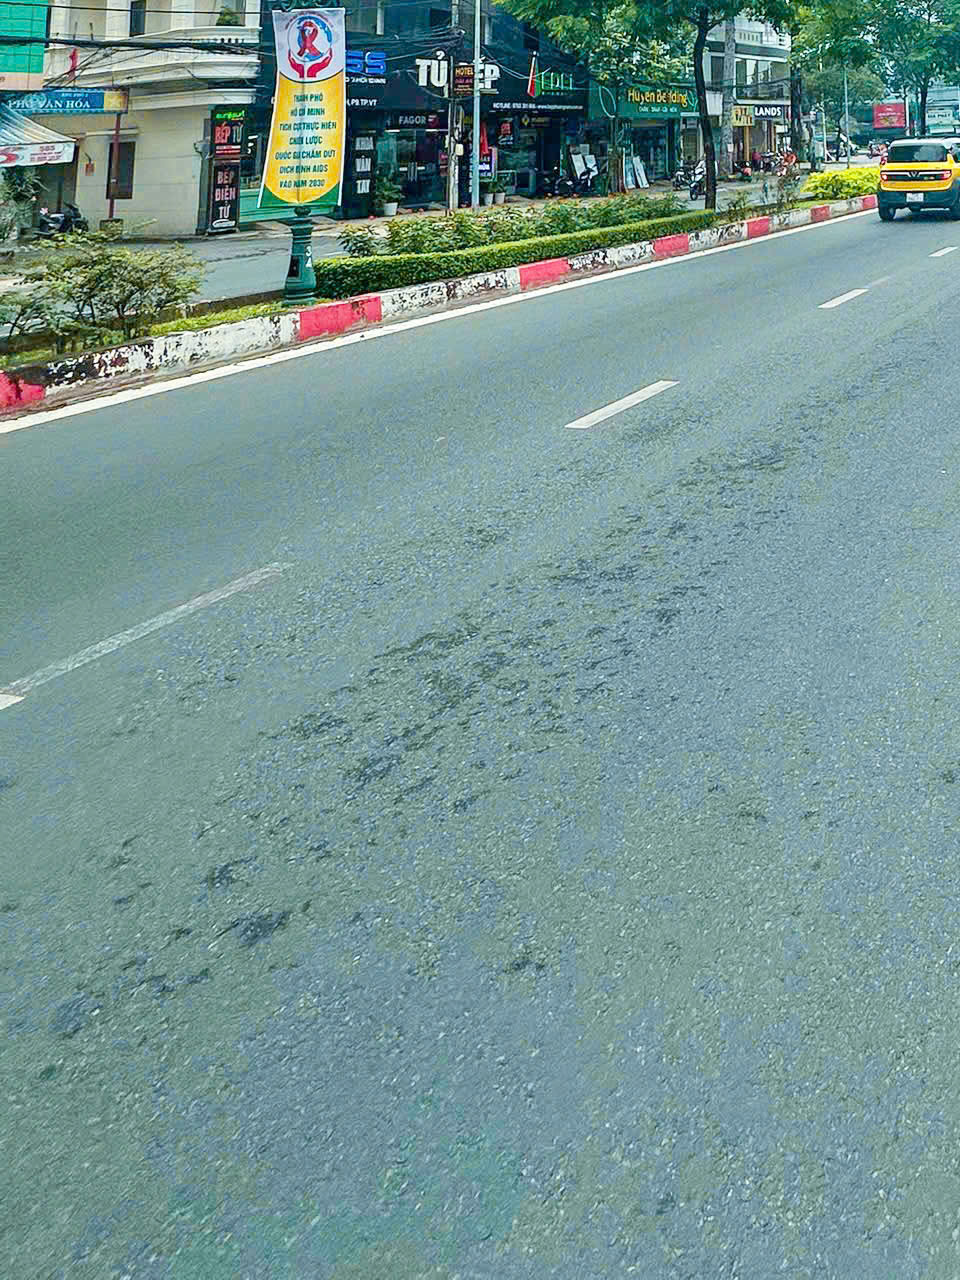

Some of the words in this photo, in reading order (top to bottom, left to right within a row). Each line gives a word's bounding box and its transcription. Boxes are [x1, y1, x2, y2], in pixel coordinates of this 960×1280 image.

[416, 50, 449, 87] TỦ
[455, 66, 474, 77] HOTEL
[307, 108, 325, 116] MINH
[754, 106, 782, 116] LANDS
[399, 115, 427, 125] FAGOR
[312, 164, 328, 173] AIDS
